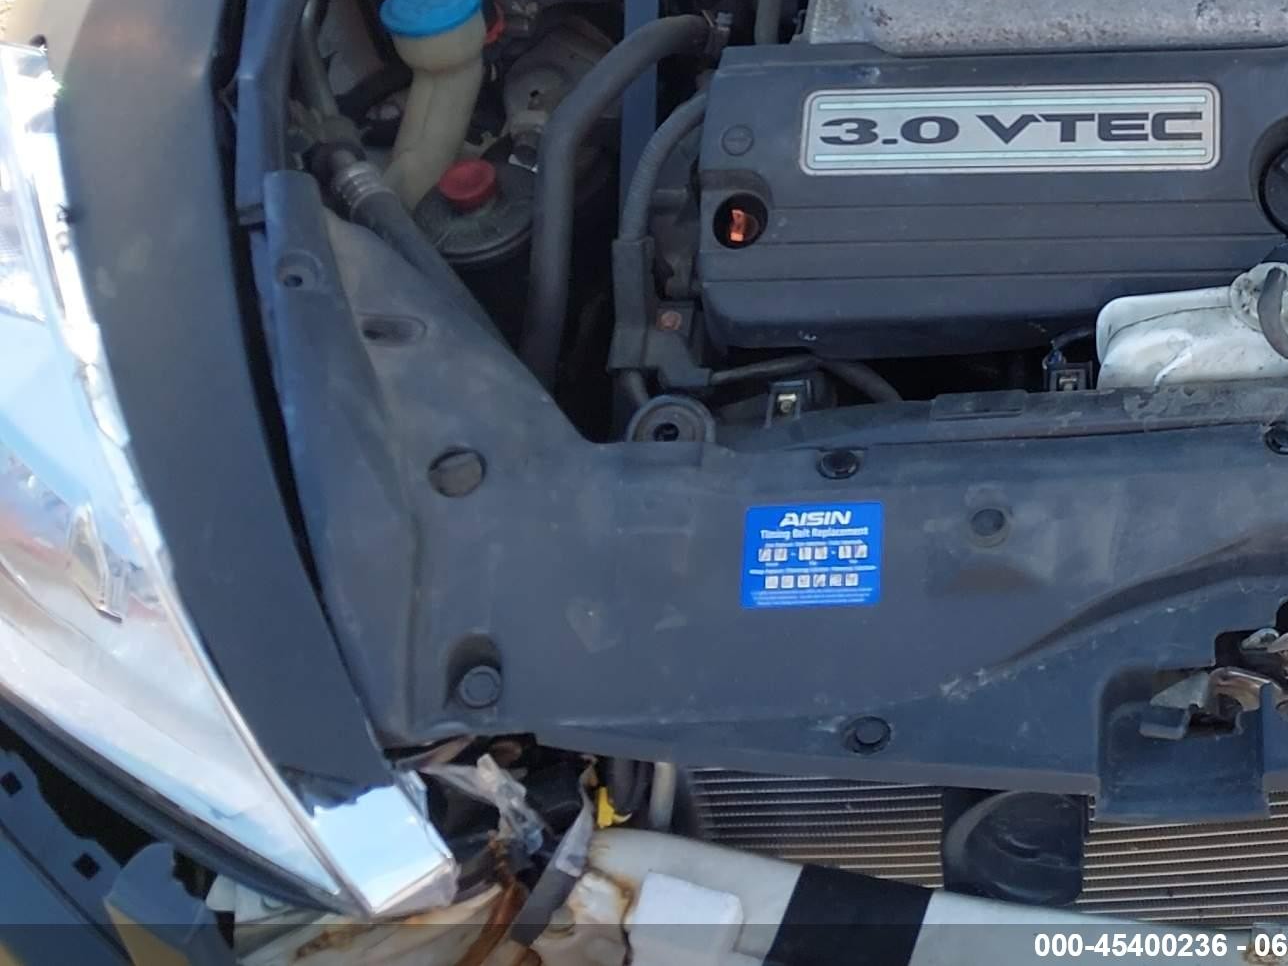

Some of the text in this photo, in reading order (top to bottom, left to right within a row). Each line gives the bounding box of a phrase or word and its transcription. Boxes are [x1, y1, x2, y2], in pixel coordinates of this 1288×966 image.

[819, 111, 1203, 145] 3.0 VTEC
[779, 510, 852, 527] AISIN
[760, 526, 869, 541] Timing Belt Replacement
